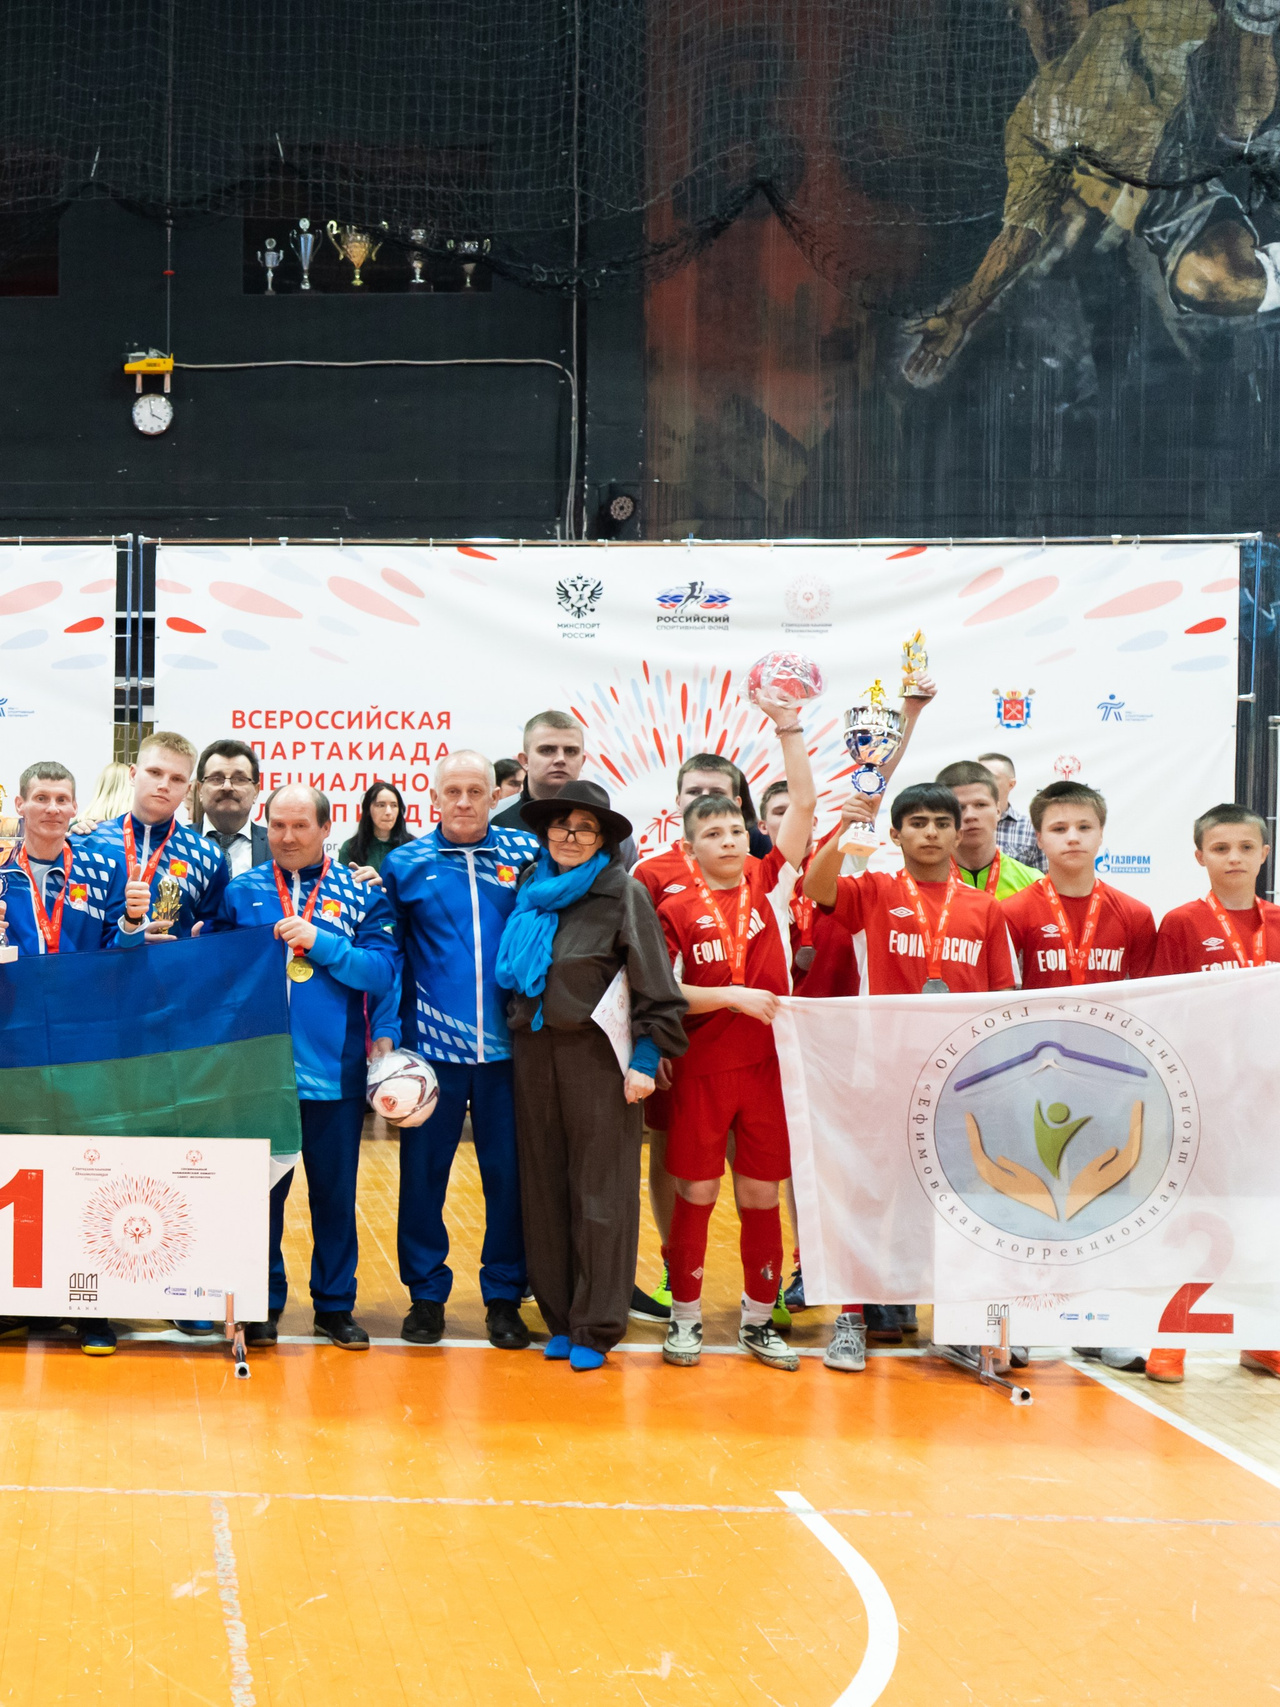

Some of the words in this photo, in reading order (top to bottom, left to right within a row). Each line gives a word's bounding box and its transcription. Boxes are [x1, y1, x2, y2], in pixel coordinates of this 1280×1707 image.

[656, 614, 730, 623] РОССИЙСКИЙ
[231, 705, 451, 730] ВСЕРОССИЙСКАЯ
[244, 741, 450, 766] ПАРТАКИАДА
[1111, 855, 1151, 864] ГАЗПРОМ
[971, 1006, 1030, 1038] ГБОУ
[935, 1043, 959, 1069] ЛО
[913, 1083, 982, 1235] «Ефимовская
[995, 1181, 1178, 1260] коррекционная
[69, 1272, 98, 1289] ДОМ
[1158, 1210, 1235, 1334] 2
